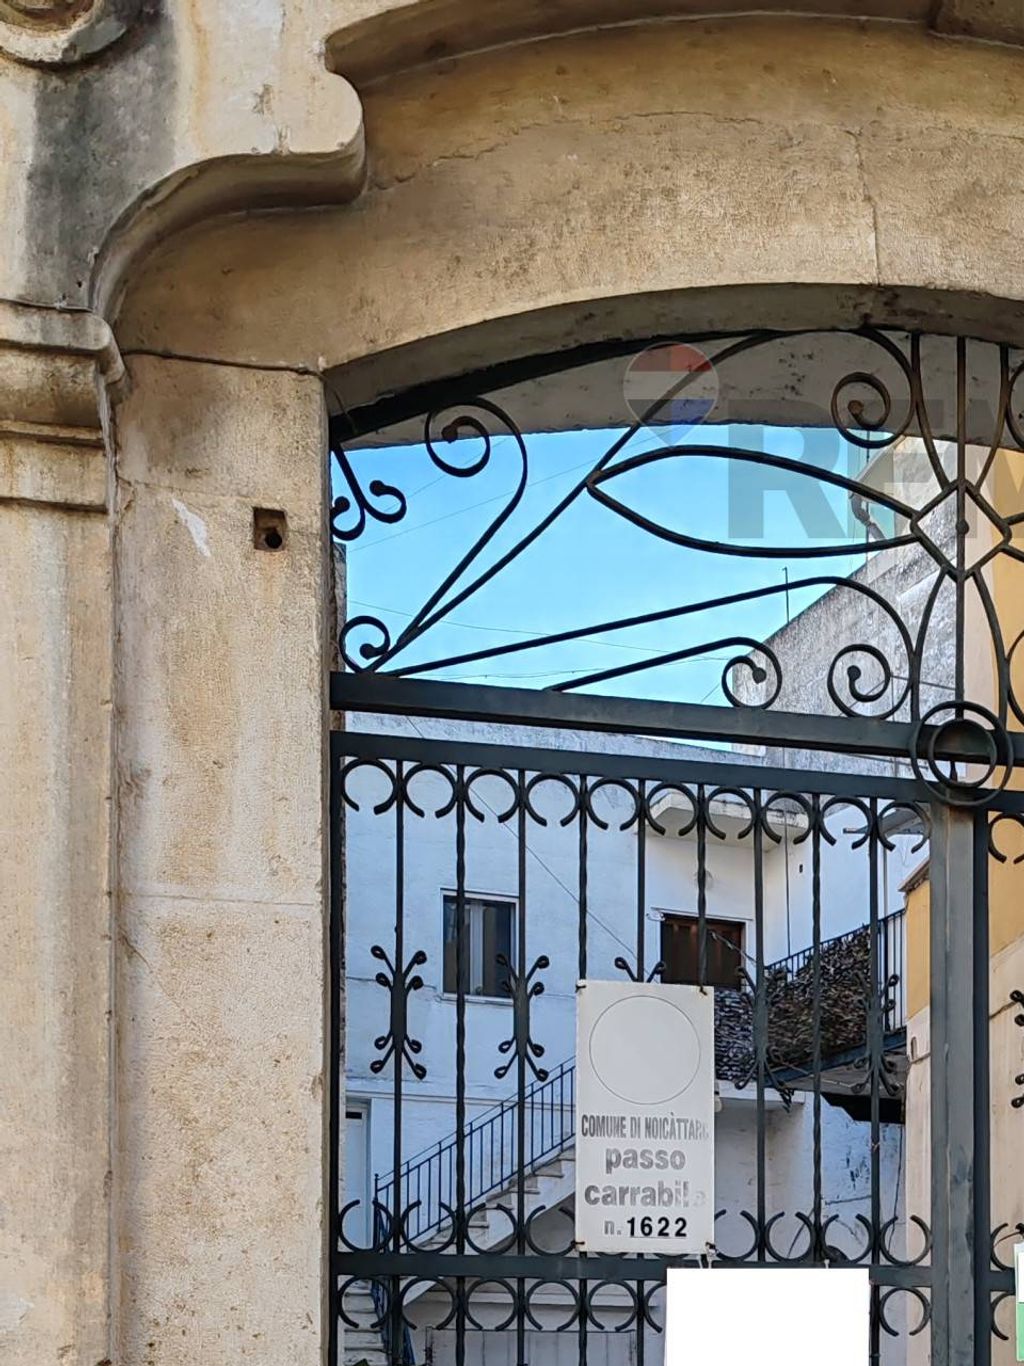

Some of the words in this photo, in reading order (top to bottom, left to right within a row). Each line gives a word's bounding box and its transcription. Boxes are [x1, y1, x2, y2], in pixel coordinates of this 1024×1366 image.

[581, 1114, 627, 1138] COMUNE
[630, 1116, 642, 1139] DI
[605, 1148, 686, 1174] passo
[626, 1216, 687, 1237] 1622
